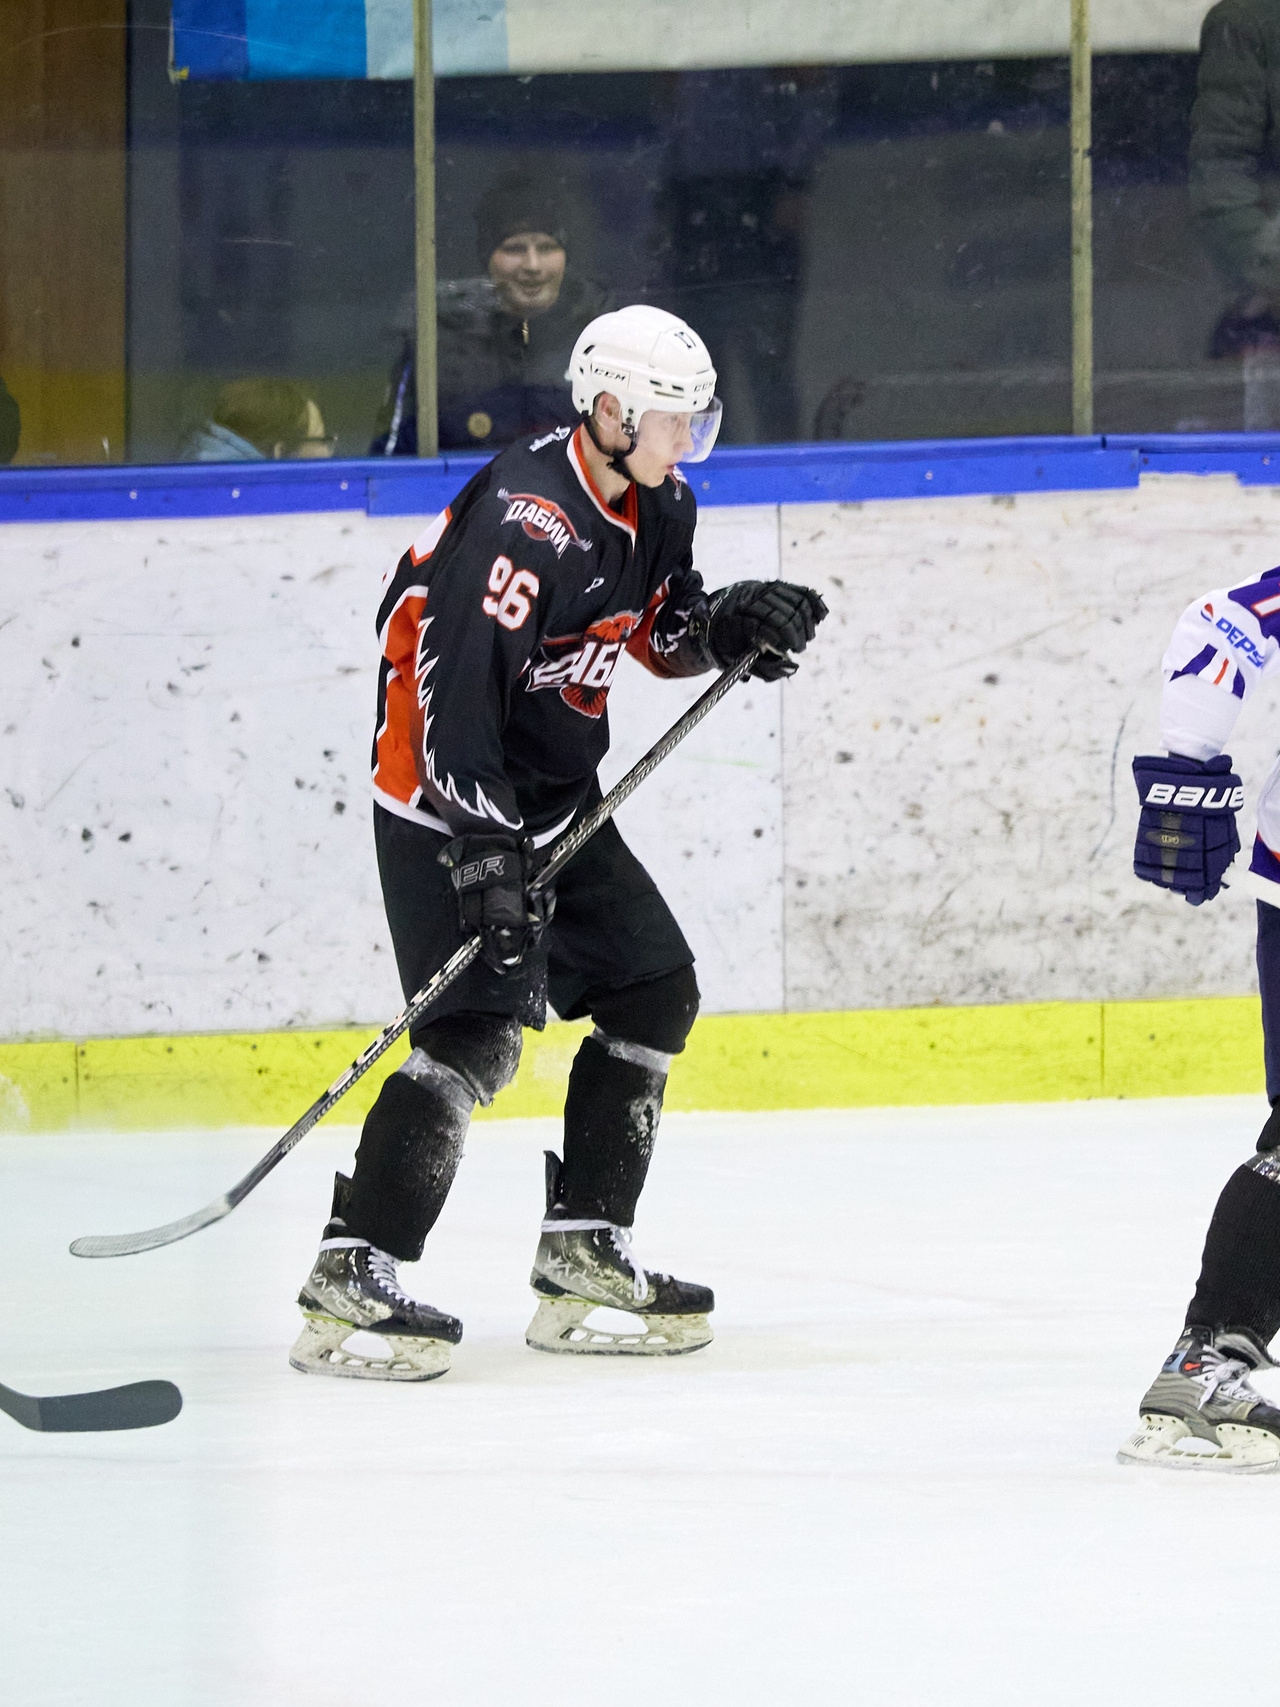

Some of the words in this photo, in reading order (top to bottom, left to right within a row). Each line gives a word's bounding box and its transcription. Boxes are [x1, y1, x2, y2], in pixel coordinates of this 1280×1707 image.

[593, 367, 626, 382] CCM
[482, 554, 541, 632] 96
[1215, 616, 1265, 669] PEPS
